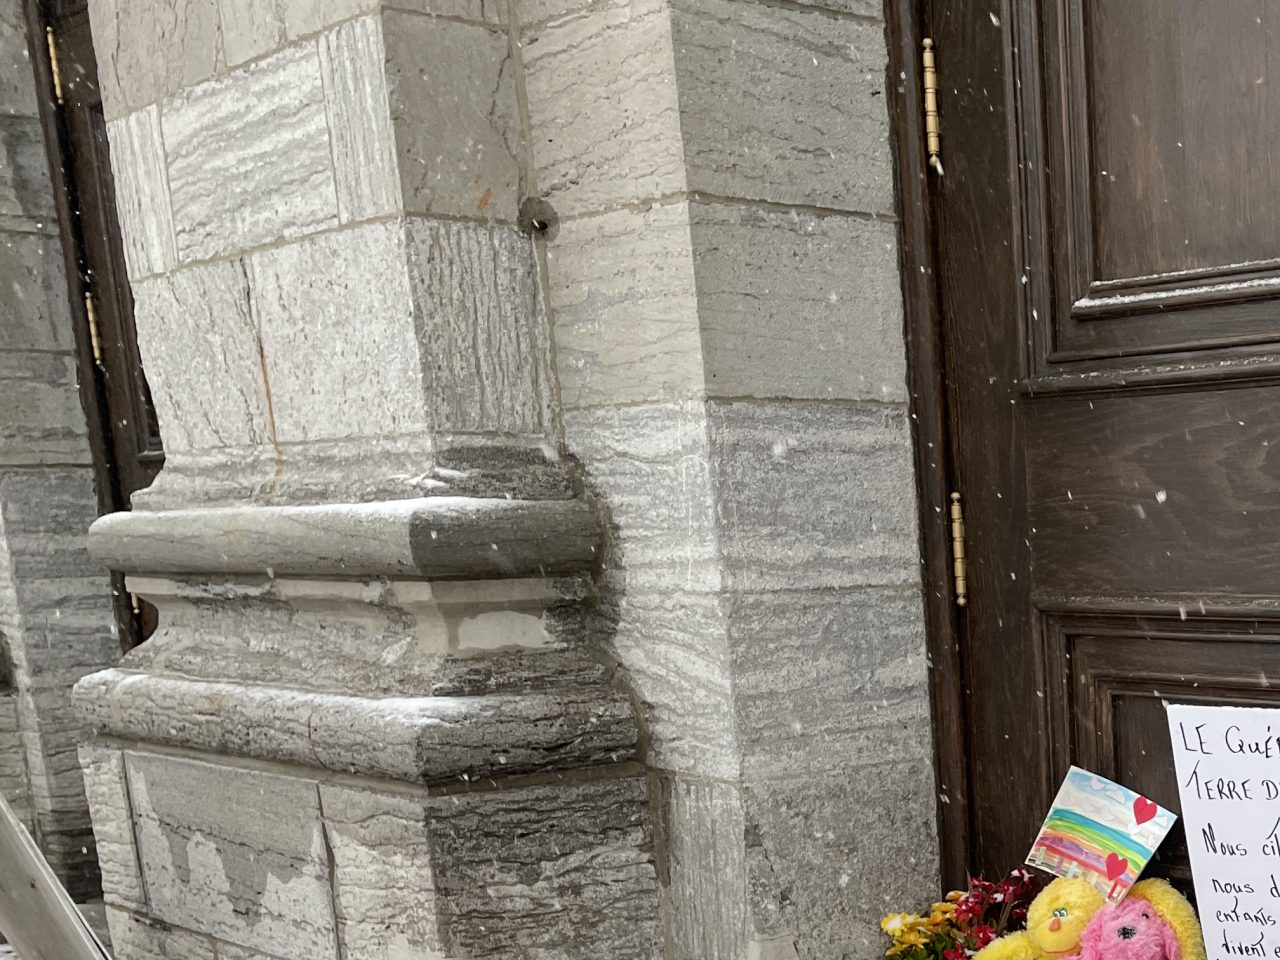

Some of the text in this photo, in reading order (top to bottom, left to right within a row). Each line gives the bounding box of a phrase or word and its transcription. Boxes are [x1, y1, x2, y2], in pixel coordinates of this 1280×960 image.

[1179, 722, 1213, 755] LE
[1185, 760, 1252, 801] TERRE
[1202, 822, 1247, 857] Nous
[1212, 878, 1254, 894] nous
[1216, 896, 1277, 927] enfants
[1221, 929, 1267, 957] vivent
